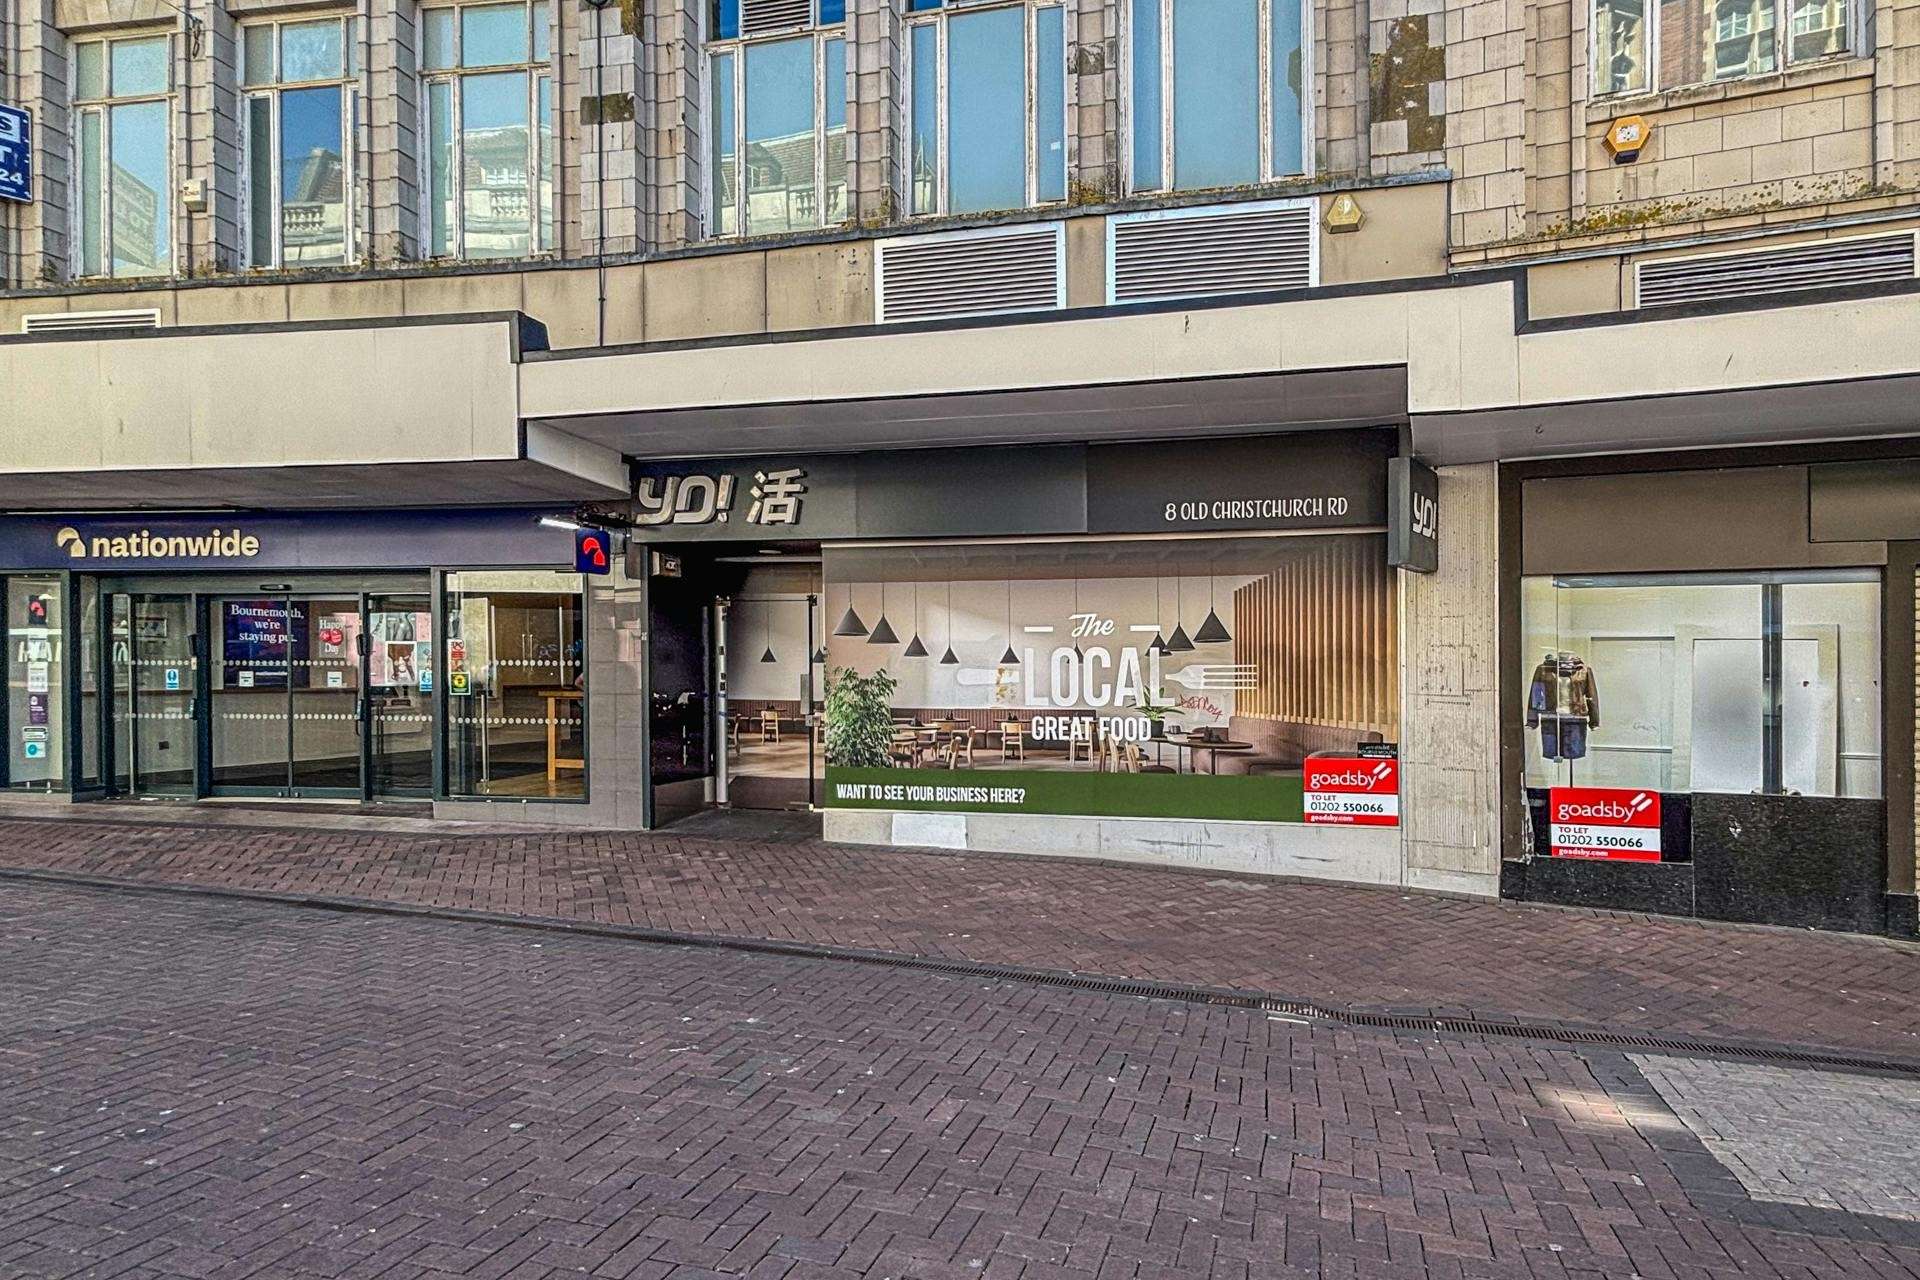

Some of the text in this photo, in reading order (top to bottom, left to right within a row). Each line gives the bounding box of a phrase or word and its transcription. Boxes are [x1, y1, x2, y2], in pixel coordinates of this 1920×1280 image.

[746, 468, 804, 525] 活
[1164, 497, 1348, 521] 8 OLD CHRISTCHURCH RD
[92, 529, 260, 558] nationwide
[254, 619, 280, 629] we're
[1068, 613, 1116, 638] The
[239, 631, 277, 643] staying
[1024, 646, 1177, 708] LOCAL
[1031, 716, 1152, 742] GREAT FOOD
[1311, 770, 1377, 790] goadsby
[836, 783, 1026, 804] WANT TO SEE YOUR BUSINESS HERE?
[1310, 801, 1384, 813] 01202 550066
[1558, 800, 1636, 823] goadsby
[1310, 814, 1354, 822] goadsby.com
[1558, 826, 1572, 834] TO
[1558, 834, 1643, 848] 01202 550066
[1558, 849, 1609, 857] goadsby.com
